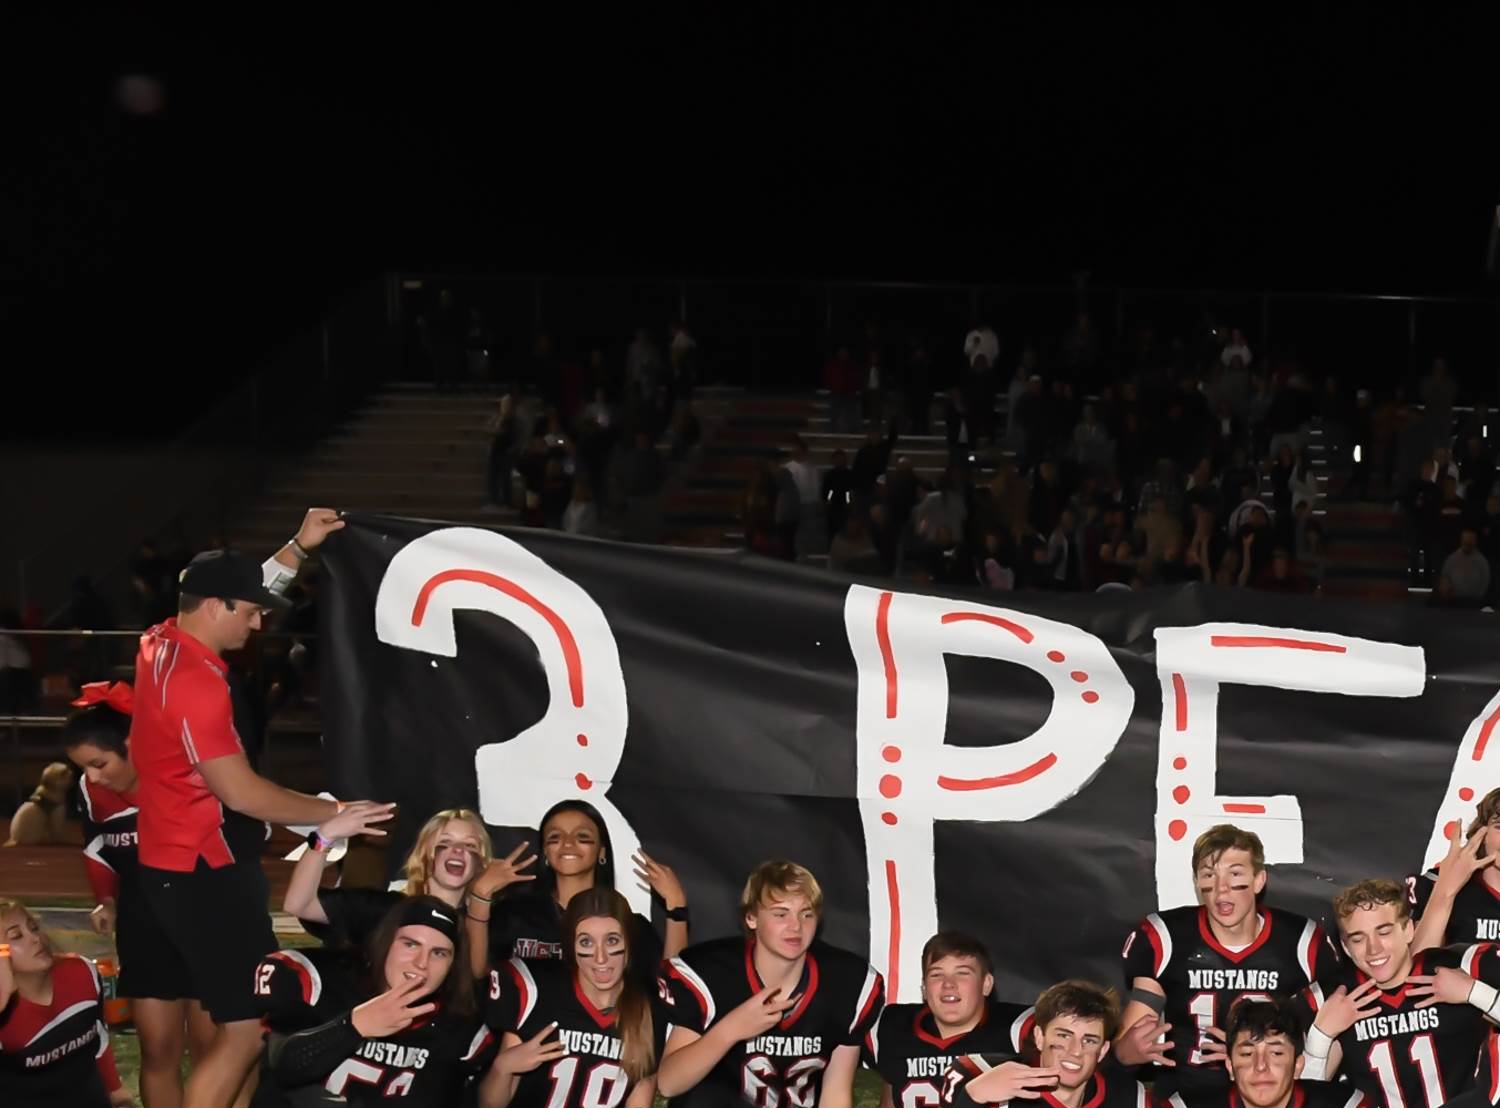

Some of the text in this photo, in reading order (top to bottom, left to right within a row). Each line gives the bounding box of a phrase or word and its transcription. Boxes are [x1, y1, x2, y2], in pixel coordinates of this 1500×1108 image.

[375, 527, 652, 922] 3
[1187, 968, 1280, 991] MUSTANGS
[1353, 1006, 1441, 1042] MUSTANGS
[558, 1028, 625, 1061] MUSTAN
